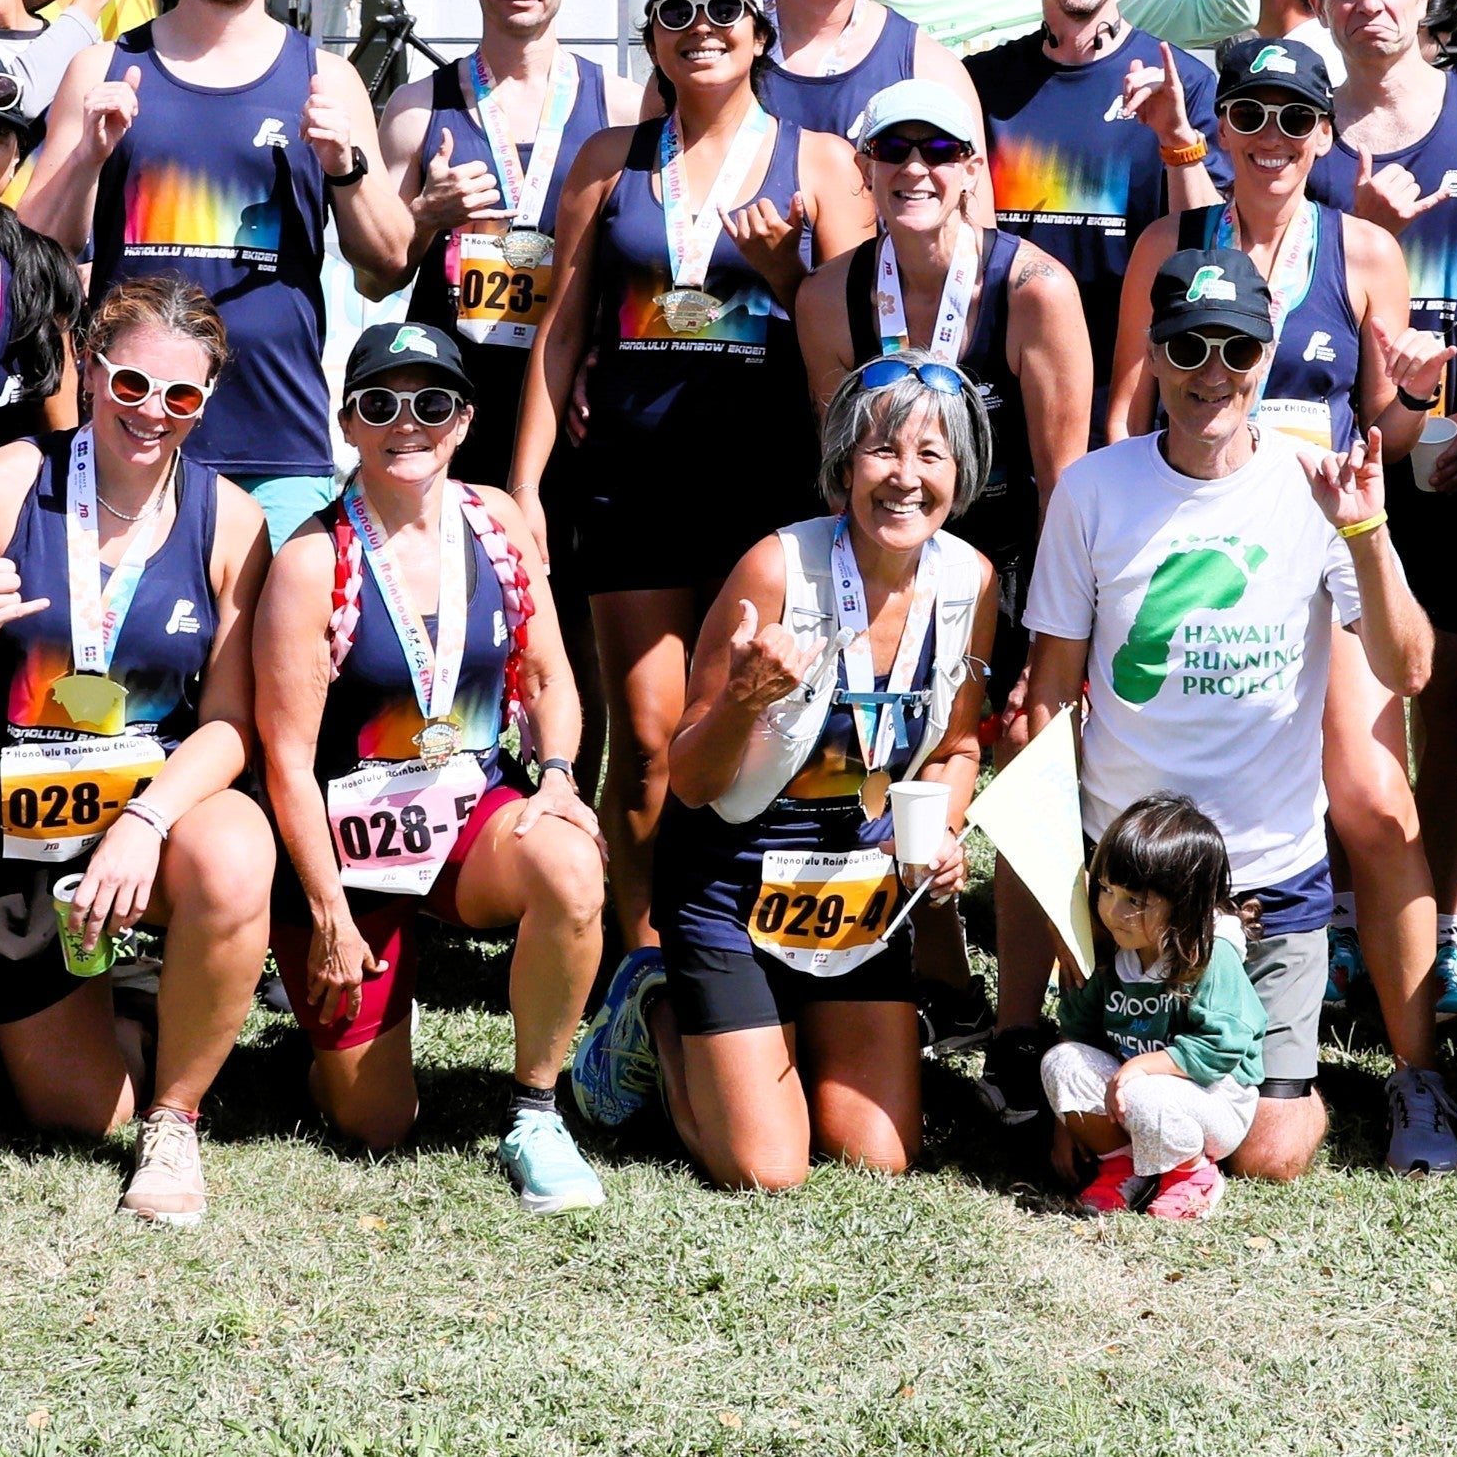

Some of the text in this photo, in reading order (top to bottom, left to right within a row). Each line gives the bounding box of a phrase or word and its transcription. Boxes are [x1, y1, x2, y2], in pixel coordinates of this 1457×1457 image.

[463, 269, 548, 314] 023-
[619, 340, 767, 356] HONOLULU RAINBOW EKIDEN
[351, 496, 384, 559] Honolulu
[380, 563, 410, 627] Rainbow
[1184, 623, 1286, 644] HAWAI'I
[1184, 644, 1302, 671] RUNNING
[1183, 671, 1286, 700] PROJECT
[6, 724, 75, 741] HONOLULU
[14, 748, 61, 759] Honolulu
[64, 745, 110, 756] Rainbow
[341, 773, 382, 790] Honolulu
[776, 856, 820, 866] Honolulu
[822, 856, 860, 866] Rainbow
[756, 891, 889, 938] 029-4
